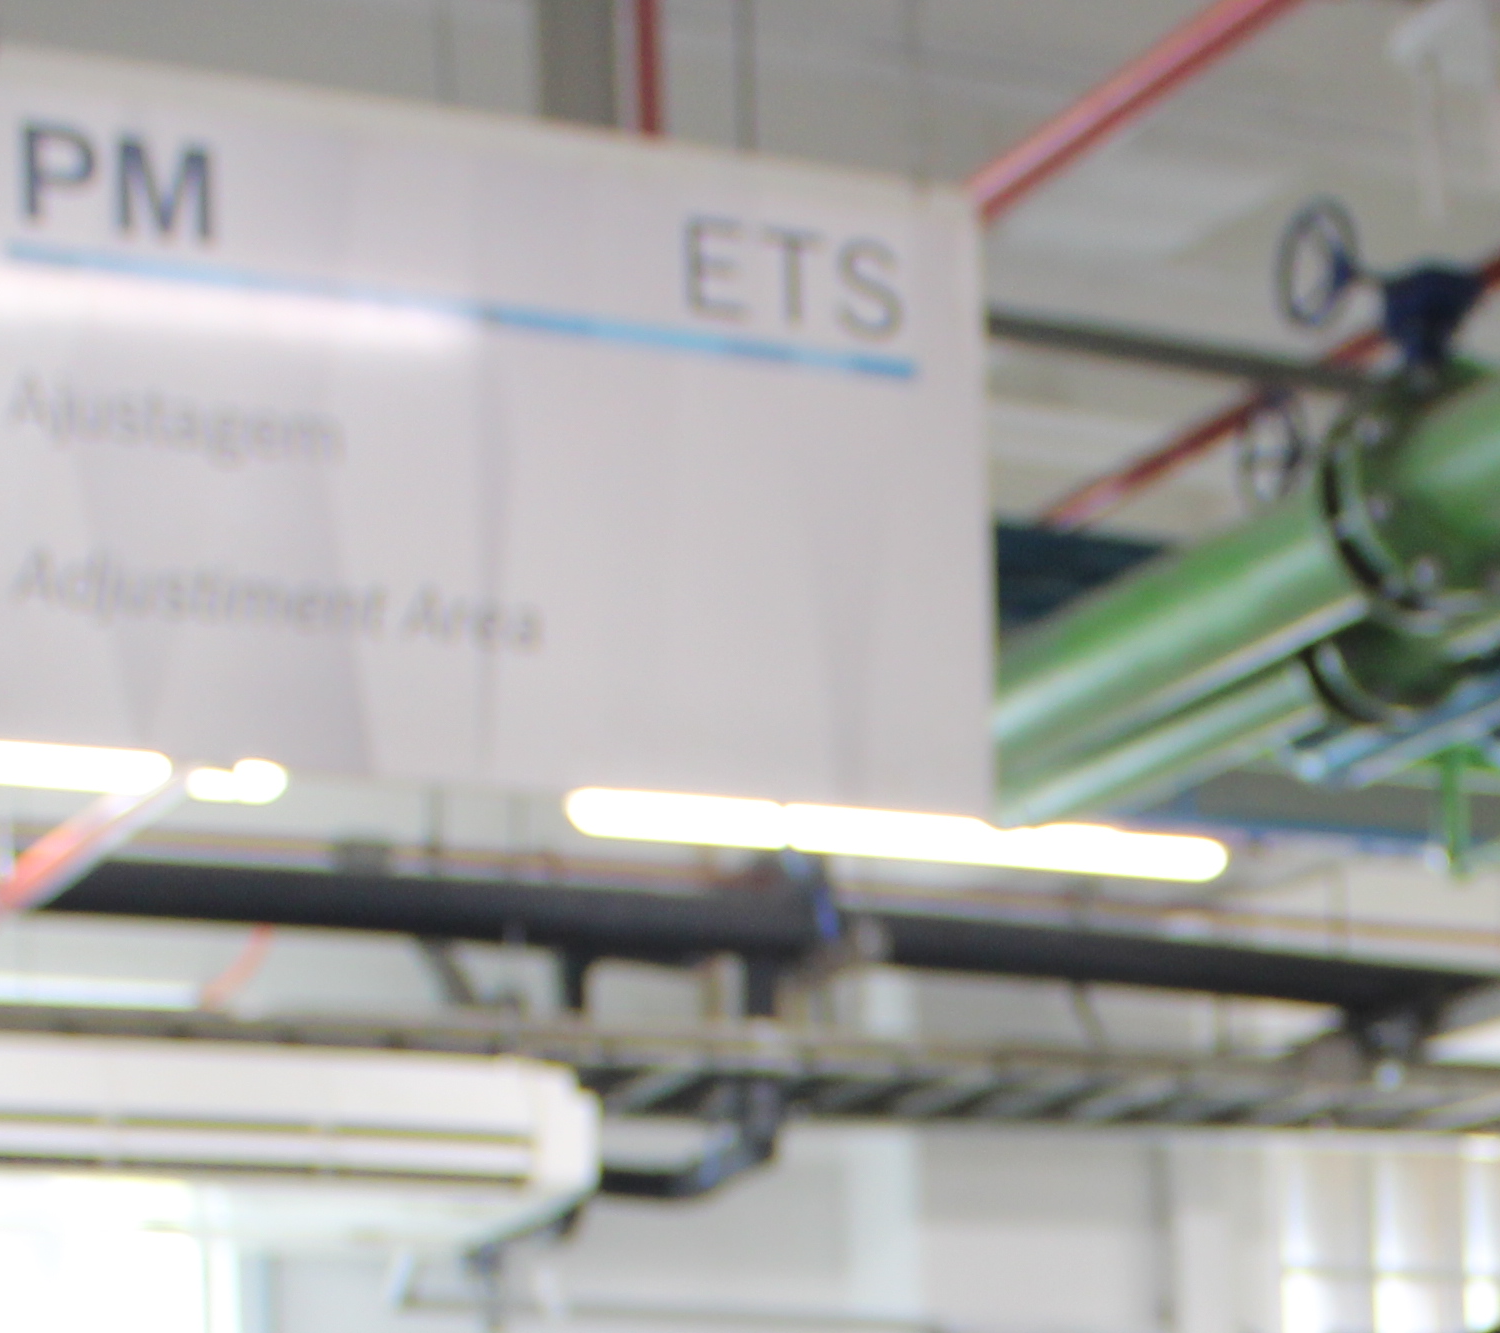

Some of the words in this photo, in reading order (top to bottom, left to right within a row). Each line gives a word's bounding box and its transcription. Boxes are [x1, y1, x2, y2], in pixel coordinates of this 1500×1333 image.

[17, 118, 218, 246] PM
[681, 212, 906, 342] ETS
[7, 371, 345, 468] Ajustagem
[9, 543, 386, 632] Adjustment
[400, 582, 543, 654] Area
